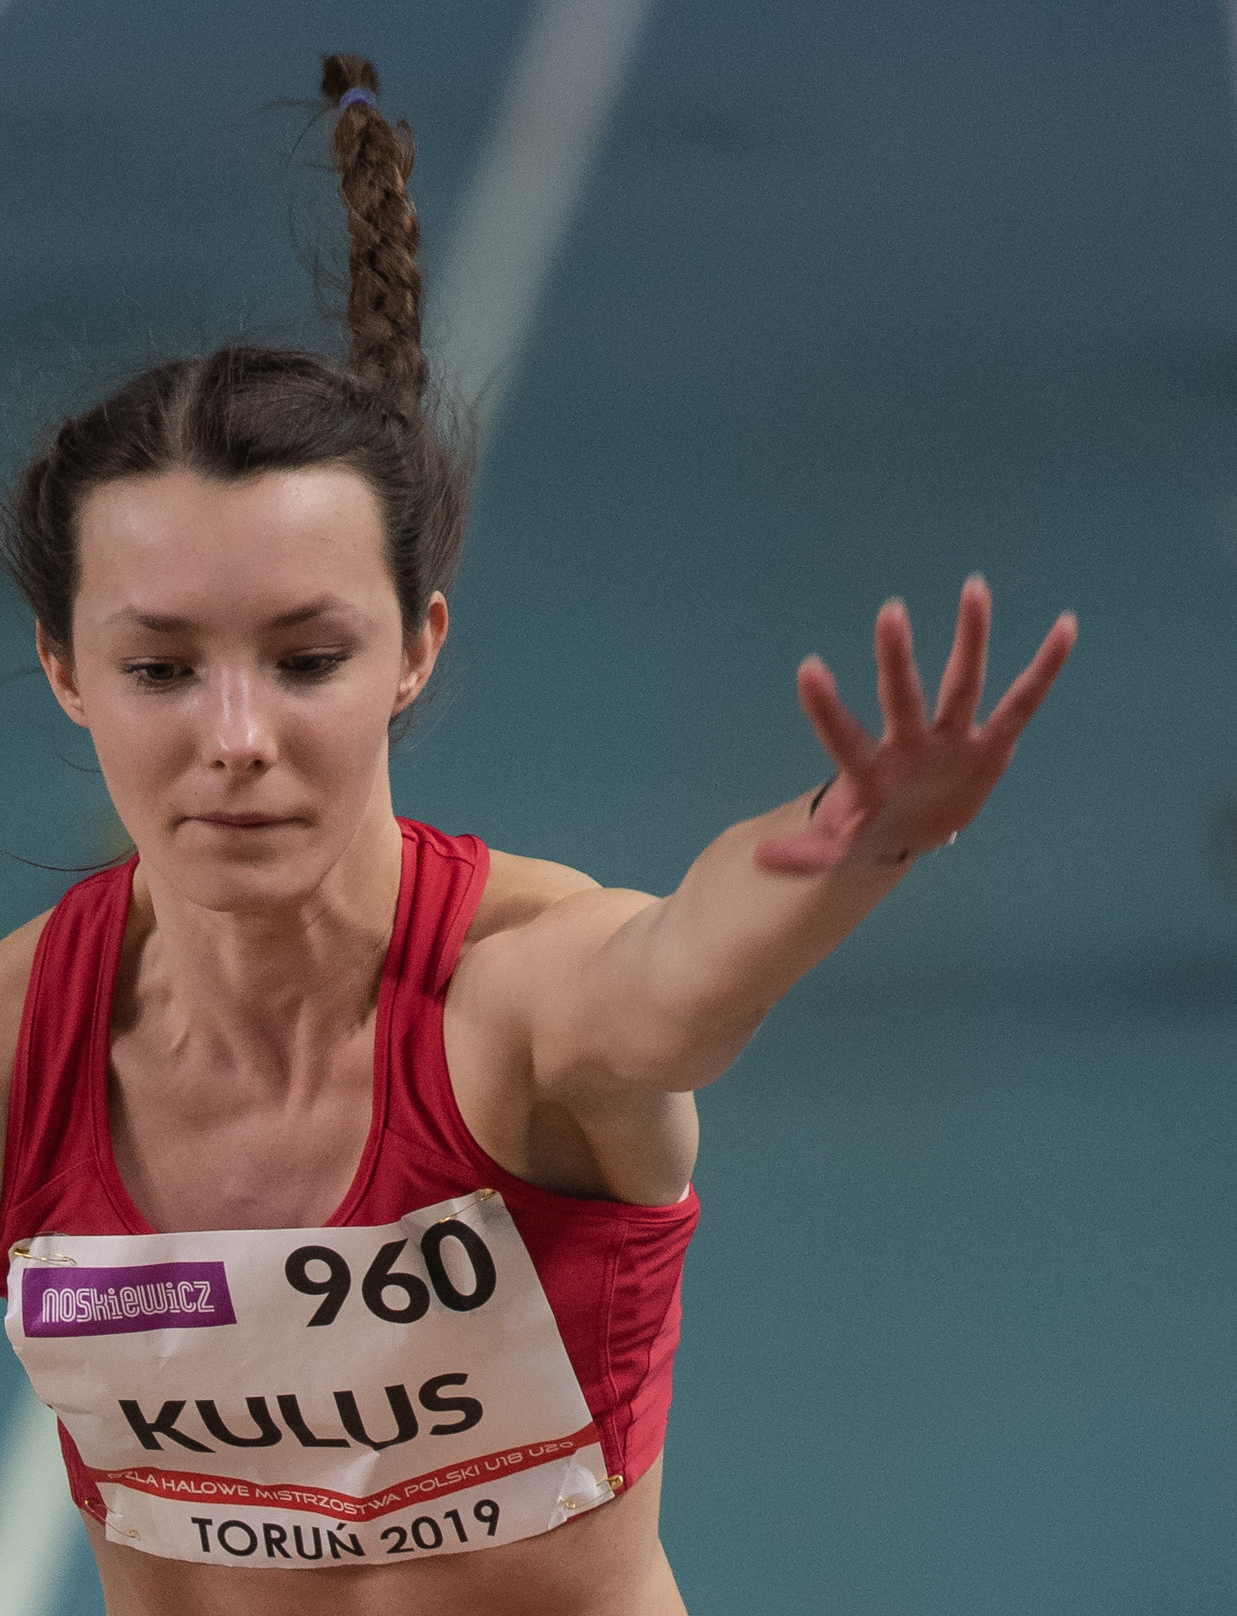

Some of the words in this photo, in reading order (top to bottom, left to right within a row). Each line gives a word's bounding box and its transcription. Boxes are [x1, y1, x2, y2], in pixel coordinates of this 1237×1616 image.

[42, 1281, 216, 1324] noskiewicz
[284, 1218, 498, 1328] 960
[118, 1372, 485, 1452] KULUS
[162, 1478, 249, 1498] HALOWE
[255, 1487, 402, 1516] MISTRZOSTWA
[403, 1464, 481, 1498] POLSKI
[485, 1452, 524, 1472] U18
[528, 1441, 574, 1457] U20
[190, 1516, 366, 1560] TORUŃ
[380, 1498, 501, 1554] 2019
